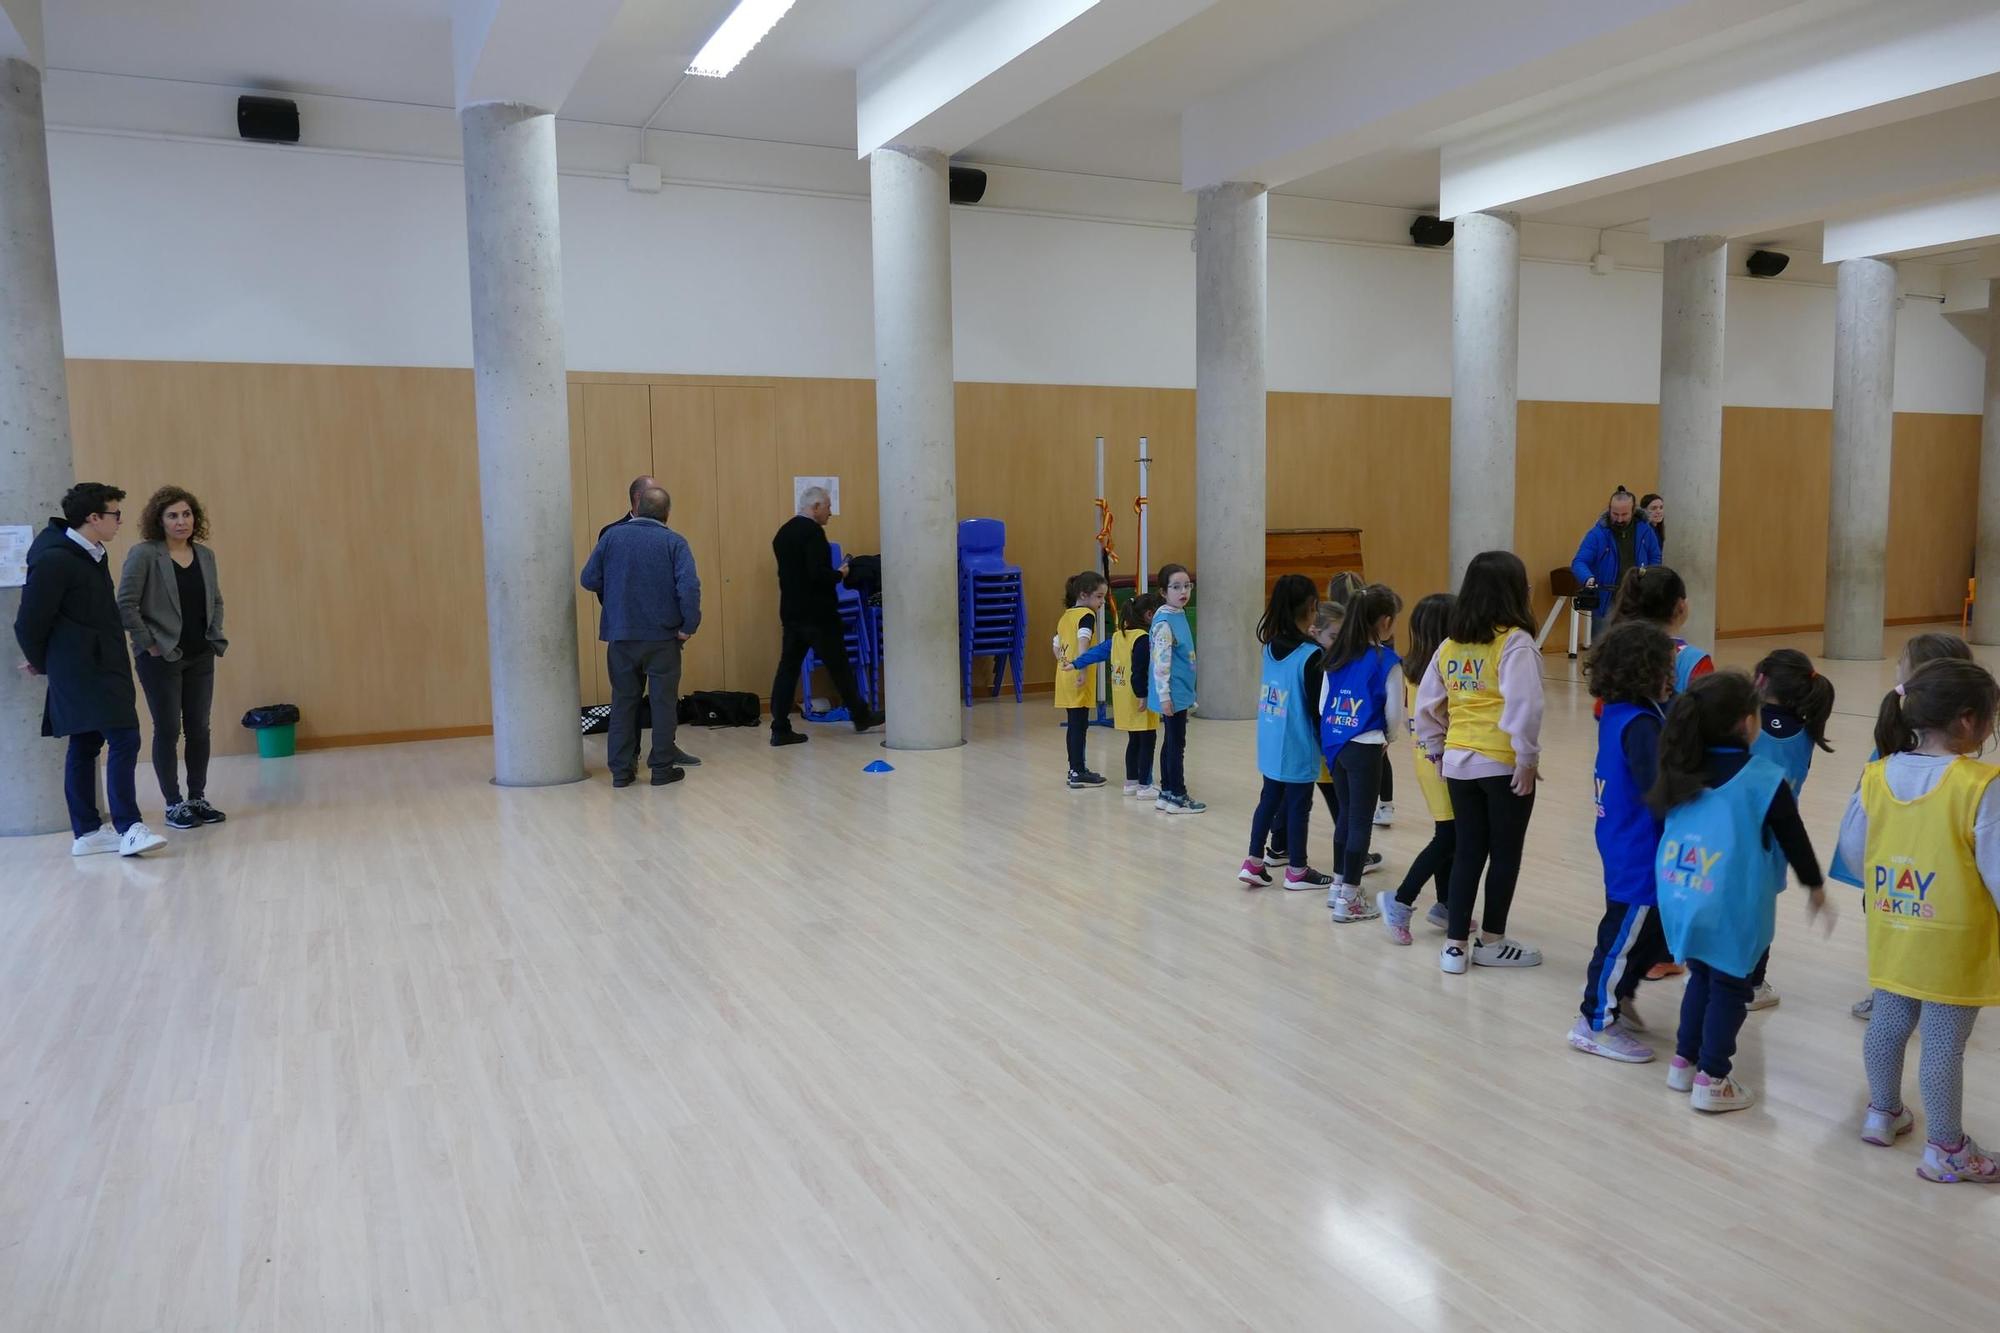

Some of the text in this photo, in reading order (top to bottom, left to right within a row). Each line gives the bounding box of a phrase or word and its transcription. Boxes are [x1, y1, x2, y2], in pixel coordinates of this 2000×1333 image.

[1447, 658, 1484, 680] PLAY
[1663, 840, 1722, 877] PLAY
[1875, 865, 1936, 901] PLAY
[1873, 898, 1935, 919] MAKERS
